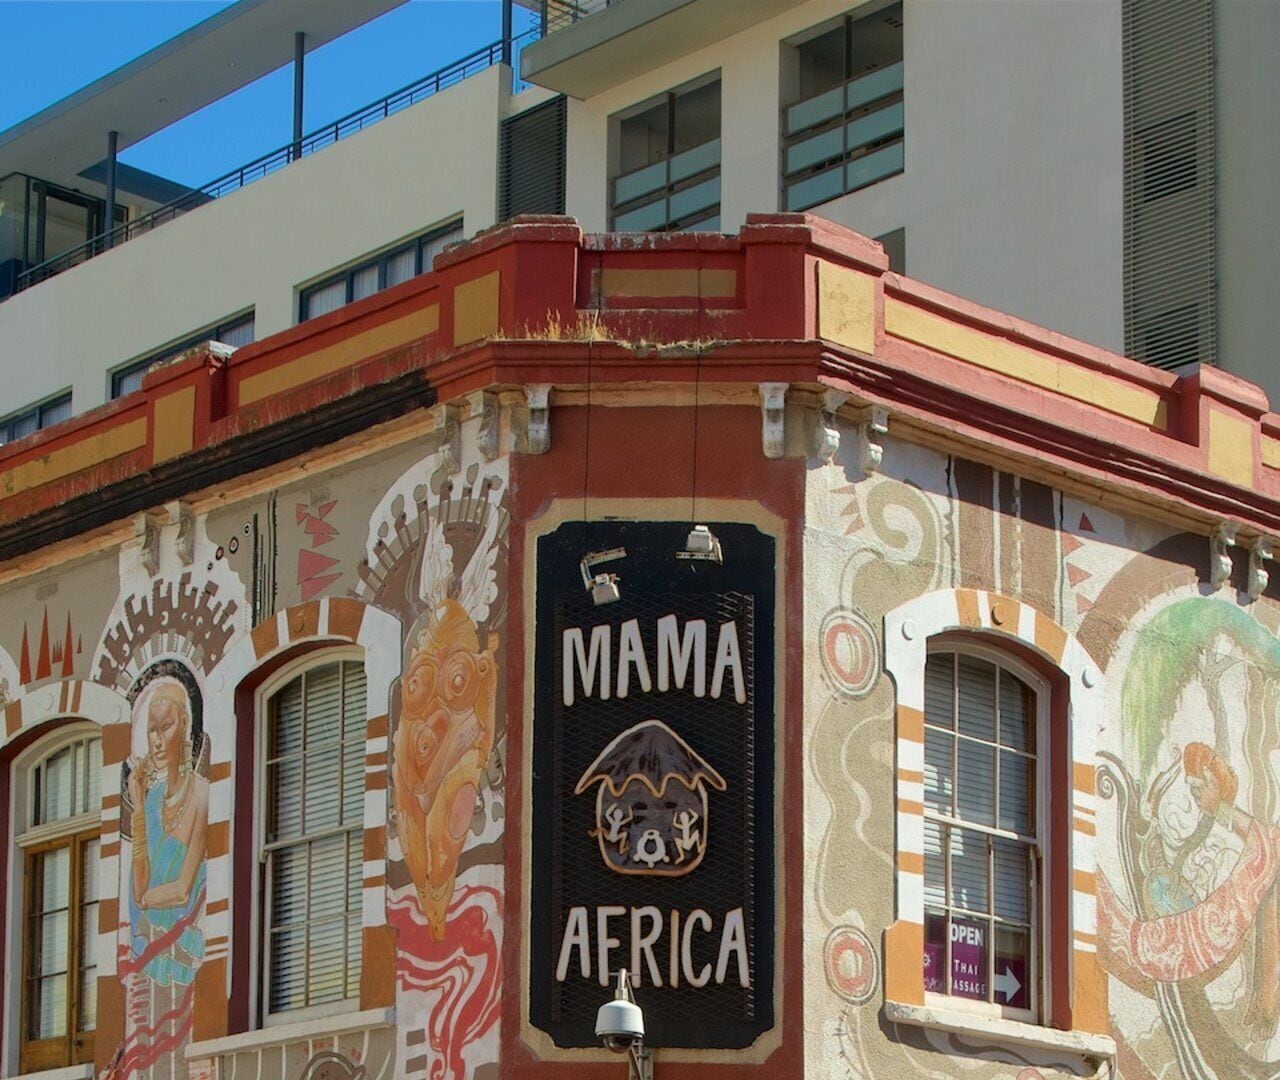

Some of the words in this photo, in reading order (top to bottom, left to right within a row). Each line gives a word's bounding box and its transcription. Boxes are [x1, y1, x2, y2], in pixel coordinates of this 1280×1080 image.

[561, 613, 747, 706] MAMA
[951, 923, 984, 946] OPEN
[554, 904, 752, 989] AFRICA
[954, 960, 979, 976] THAI
[954, 980, 987, 994] ASSAGE
